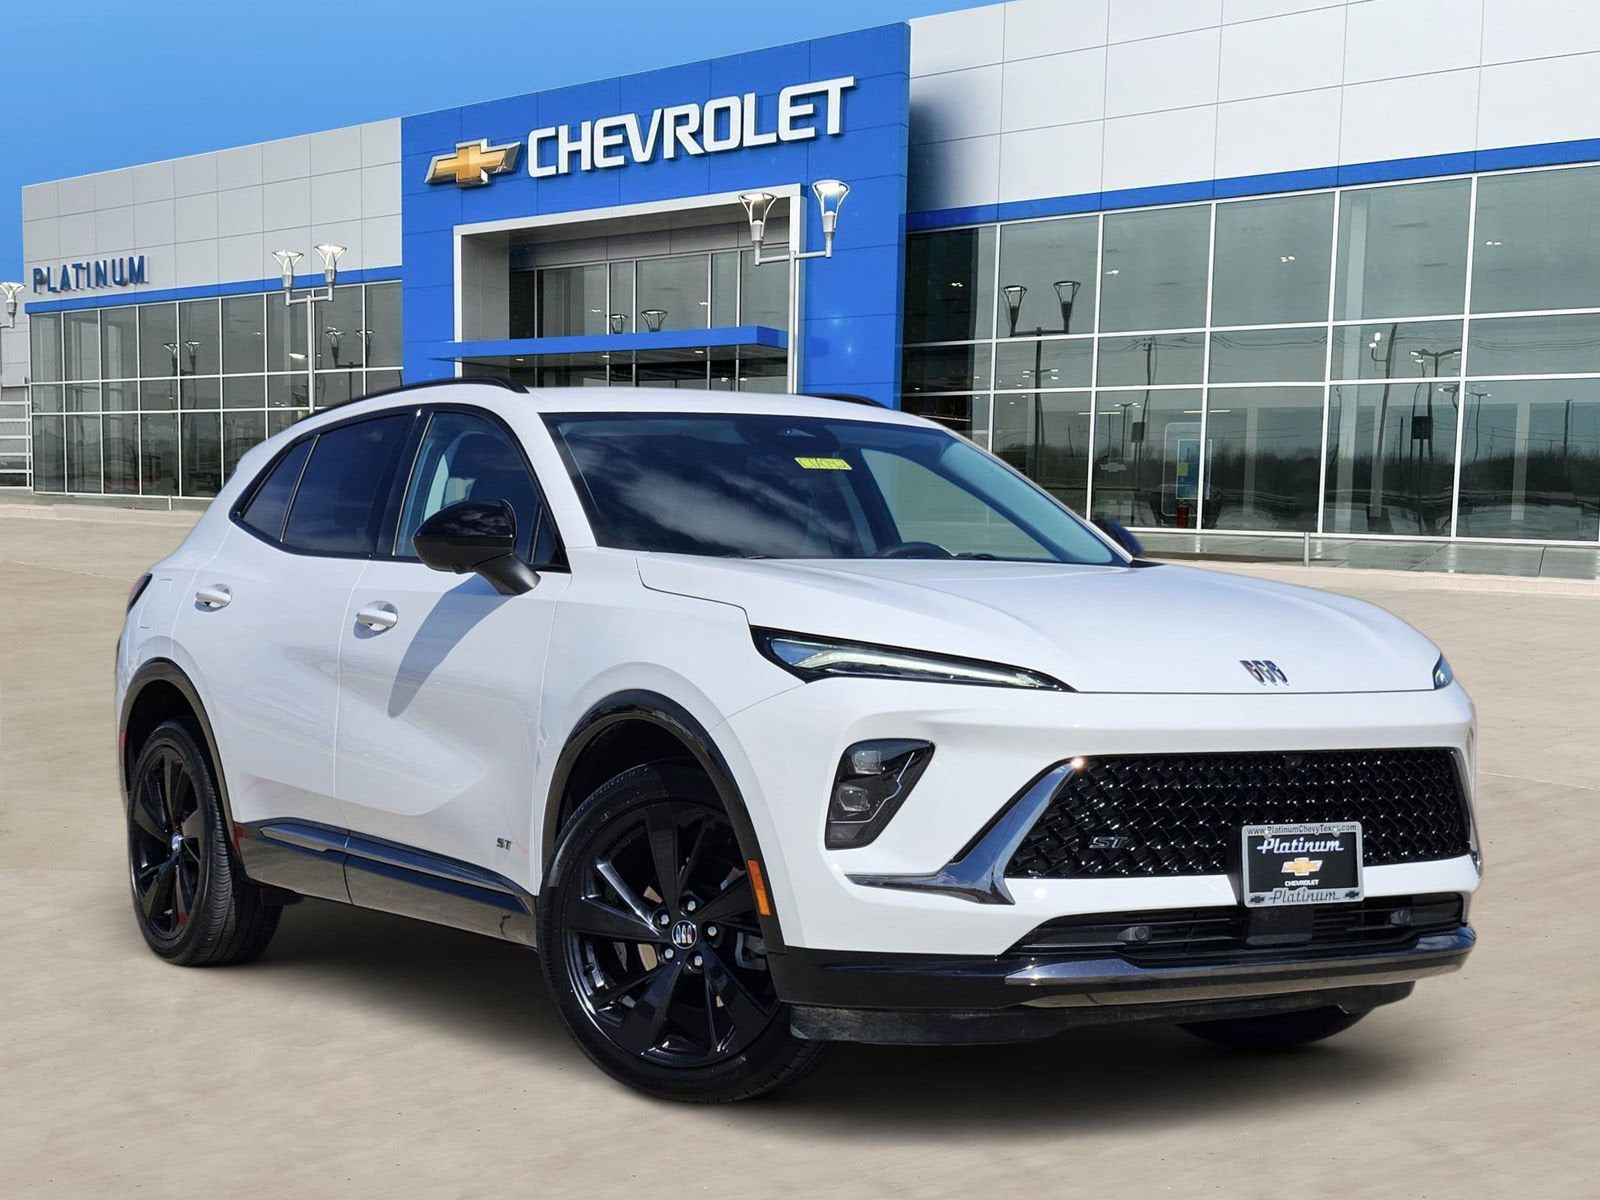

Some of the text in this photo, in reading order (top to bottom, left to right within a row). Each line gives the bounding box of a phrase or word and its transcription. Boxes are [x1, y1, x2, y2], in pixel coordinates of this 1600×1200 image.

[527, 76, 855, 178] CHEVROLET
[33, 255, 145, 294] PLATINUM
[1248, 824, 1357, 835] wwwPlatinumChevyTex.com
[496, 837, 511, 850] ST
[1089, 836, 1128, 849] ST
[1257, 837, 1344, 854] Platinum
[1269, 888, 1340, 904] Platinum
